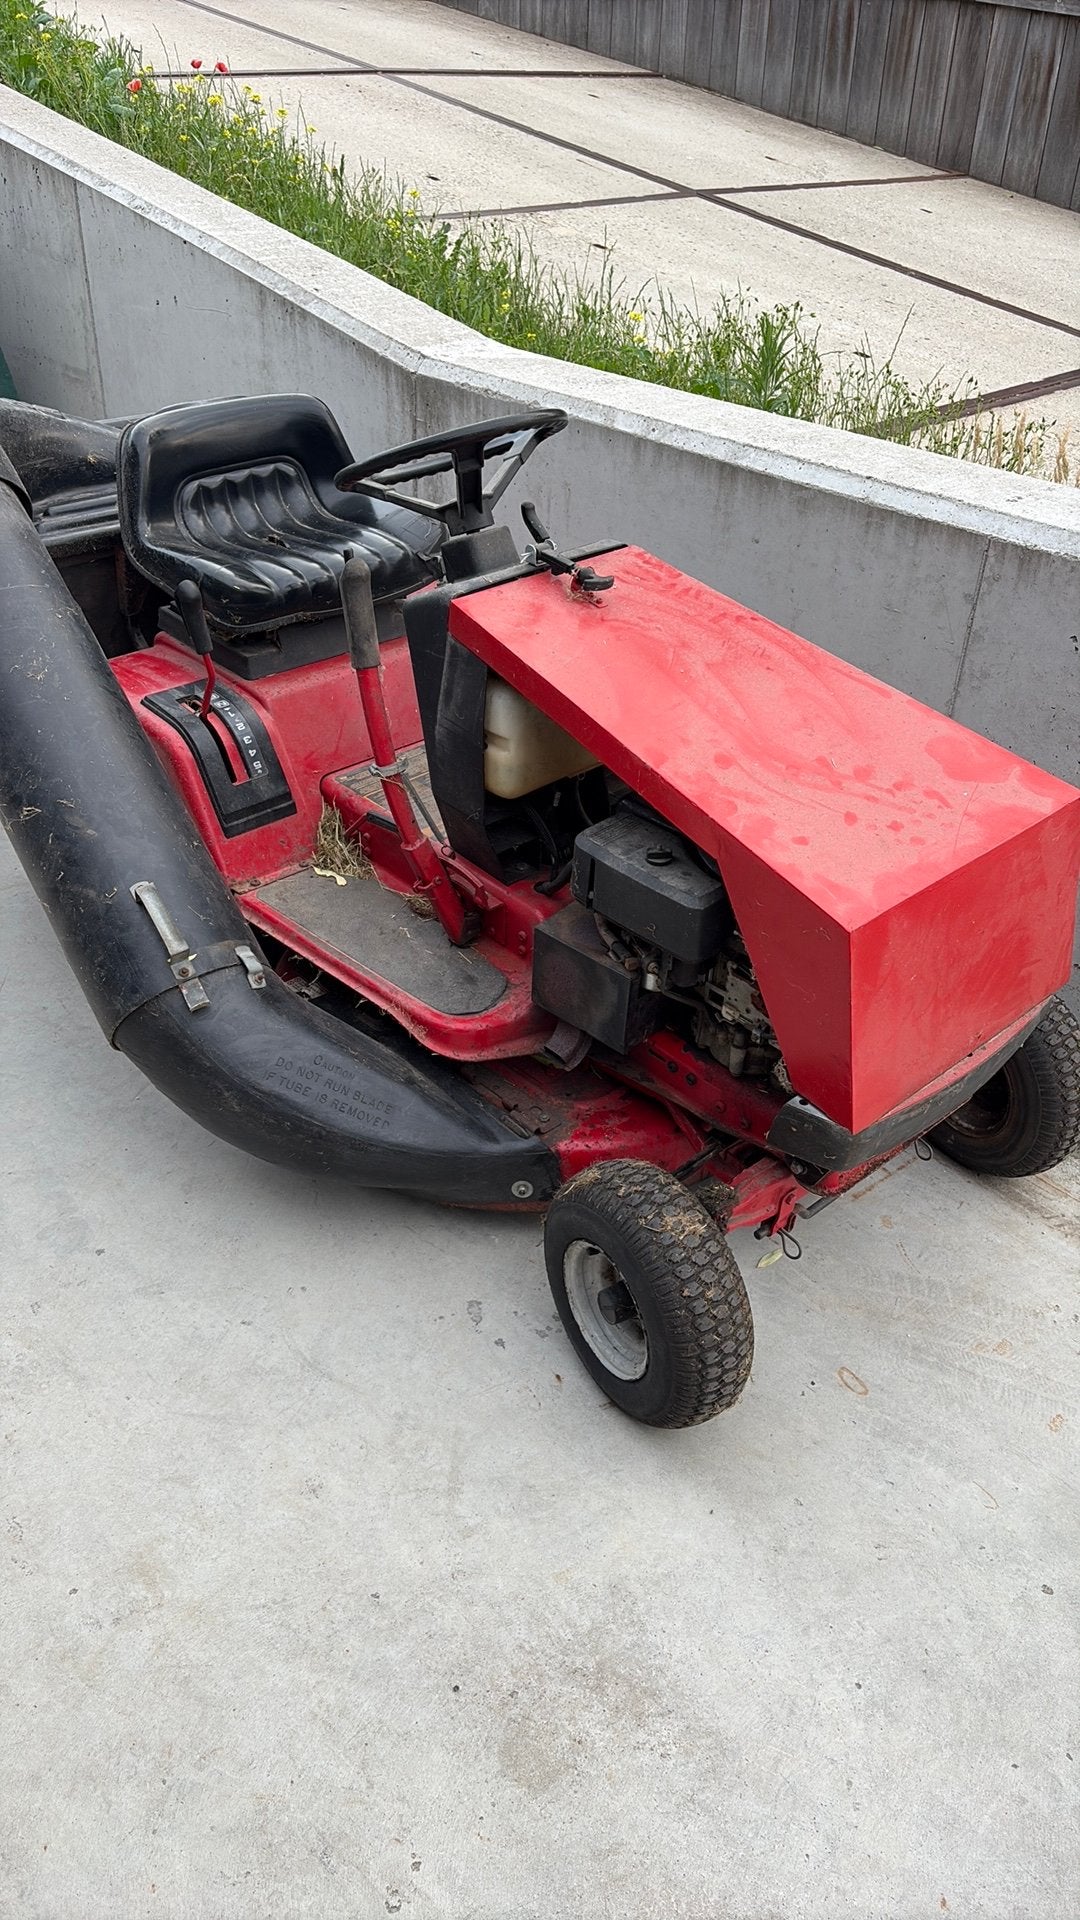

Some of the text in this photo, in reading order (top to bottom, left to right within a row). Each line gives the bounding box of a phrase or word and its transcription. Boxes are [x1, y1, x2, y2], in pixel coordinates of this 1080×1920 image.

[235, 722, 246, 731] 2
[243, 735, 252, 744] 3
[249, 749, 256, 757] 4
[253, 760, 262, 769] 5
[263, 1070, 277, 1081] IF
[279, 1076, 312, 1097] TUBE
[315, 1092, 328, 1104] IS
[274, 1056, 394, 1115] DO NOT RUN BLADE
